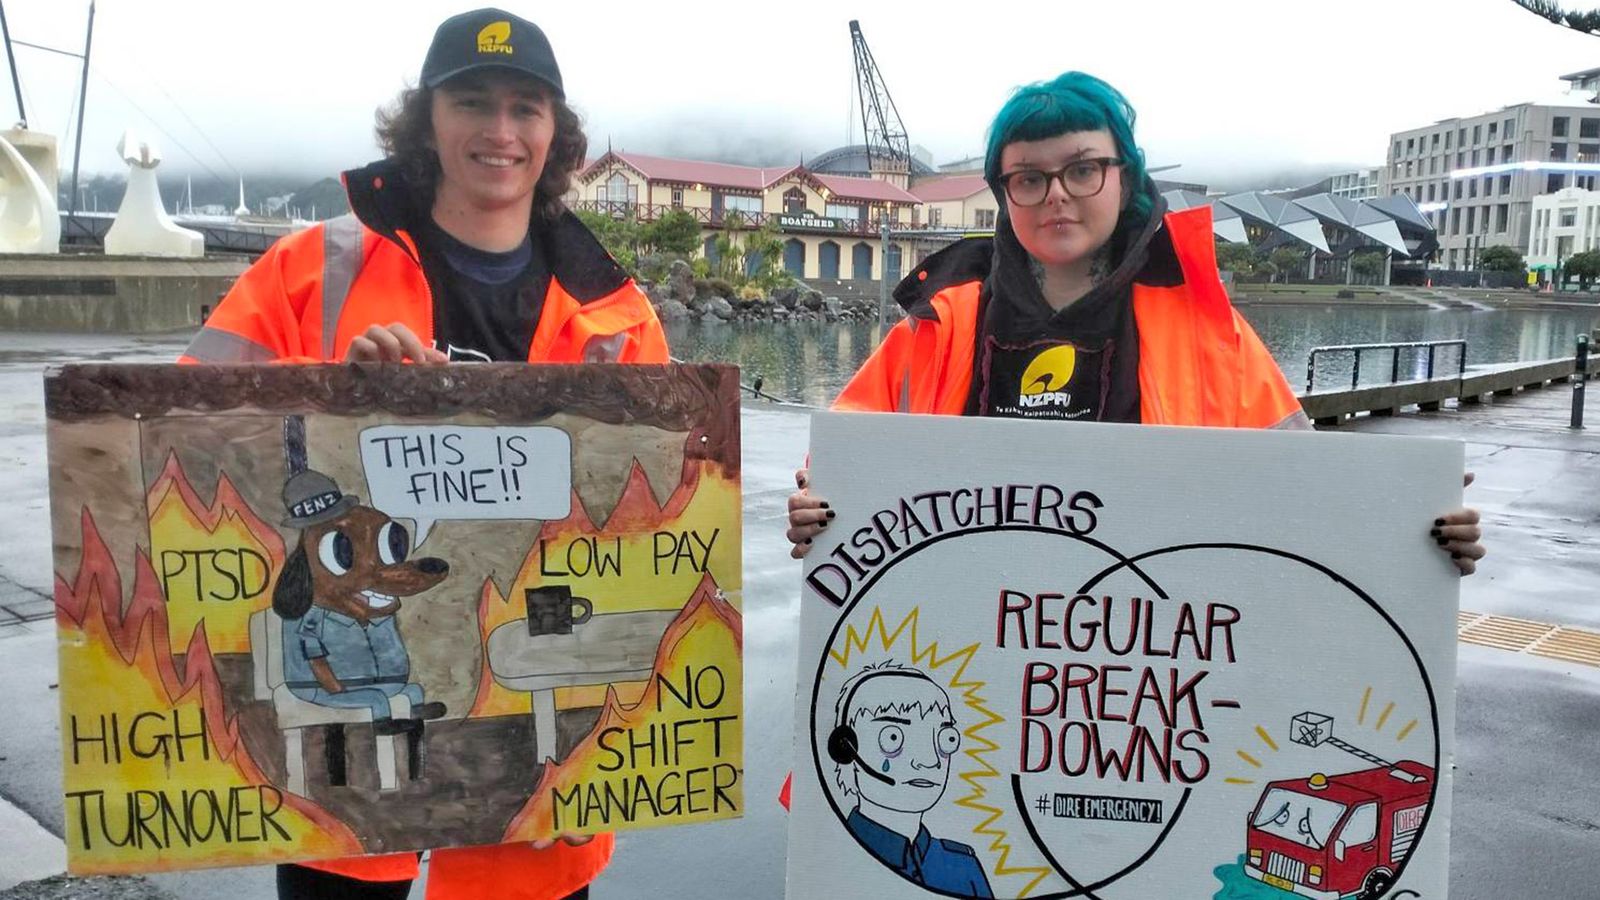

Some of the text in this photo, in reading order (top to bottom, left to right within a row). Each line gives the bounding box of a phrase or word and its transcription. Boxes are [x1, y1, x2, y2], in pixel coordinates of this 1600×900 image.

[478, 43, 513, 54] NZPFU
[781, 216, 835, 228] BOATSHED
[1019, 392, 1071, 407] NZPFU
[371, 435, 528, 468] THIS IS
[293, 494, 337, 517] FENZ
[406, 468, 522, 504] FINE!!
[540, 527, 720, 577] LOW PAY
[806, 484, 1105, 609] DISPATCHERS
[160, 549, 269, 602] PTSD
[996, 589, 1241, 663] REGULAR
[656, 665, 725, 711] NO
[1021, 662, 1241, 730] BREAK-
[71, 708, 210, 765] HIGH
[596, 716, 738, 772] SHIFT
[1020, 716, 1210, 785] DOWNS
[65, 785, 292, 850] TURNOVER
[551, 763, 740, 830] MANAGER
[1084, 798, 1161, 822] EMERGENCY!
